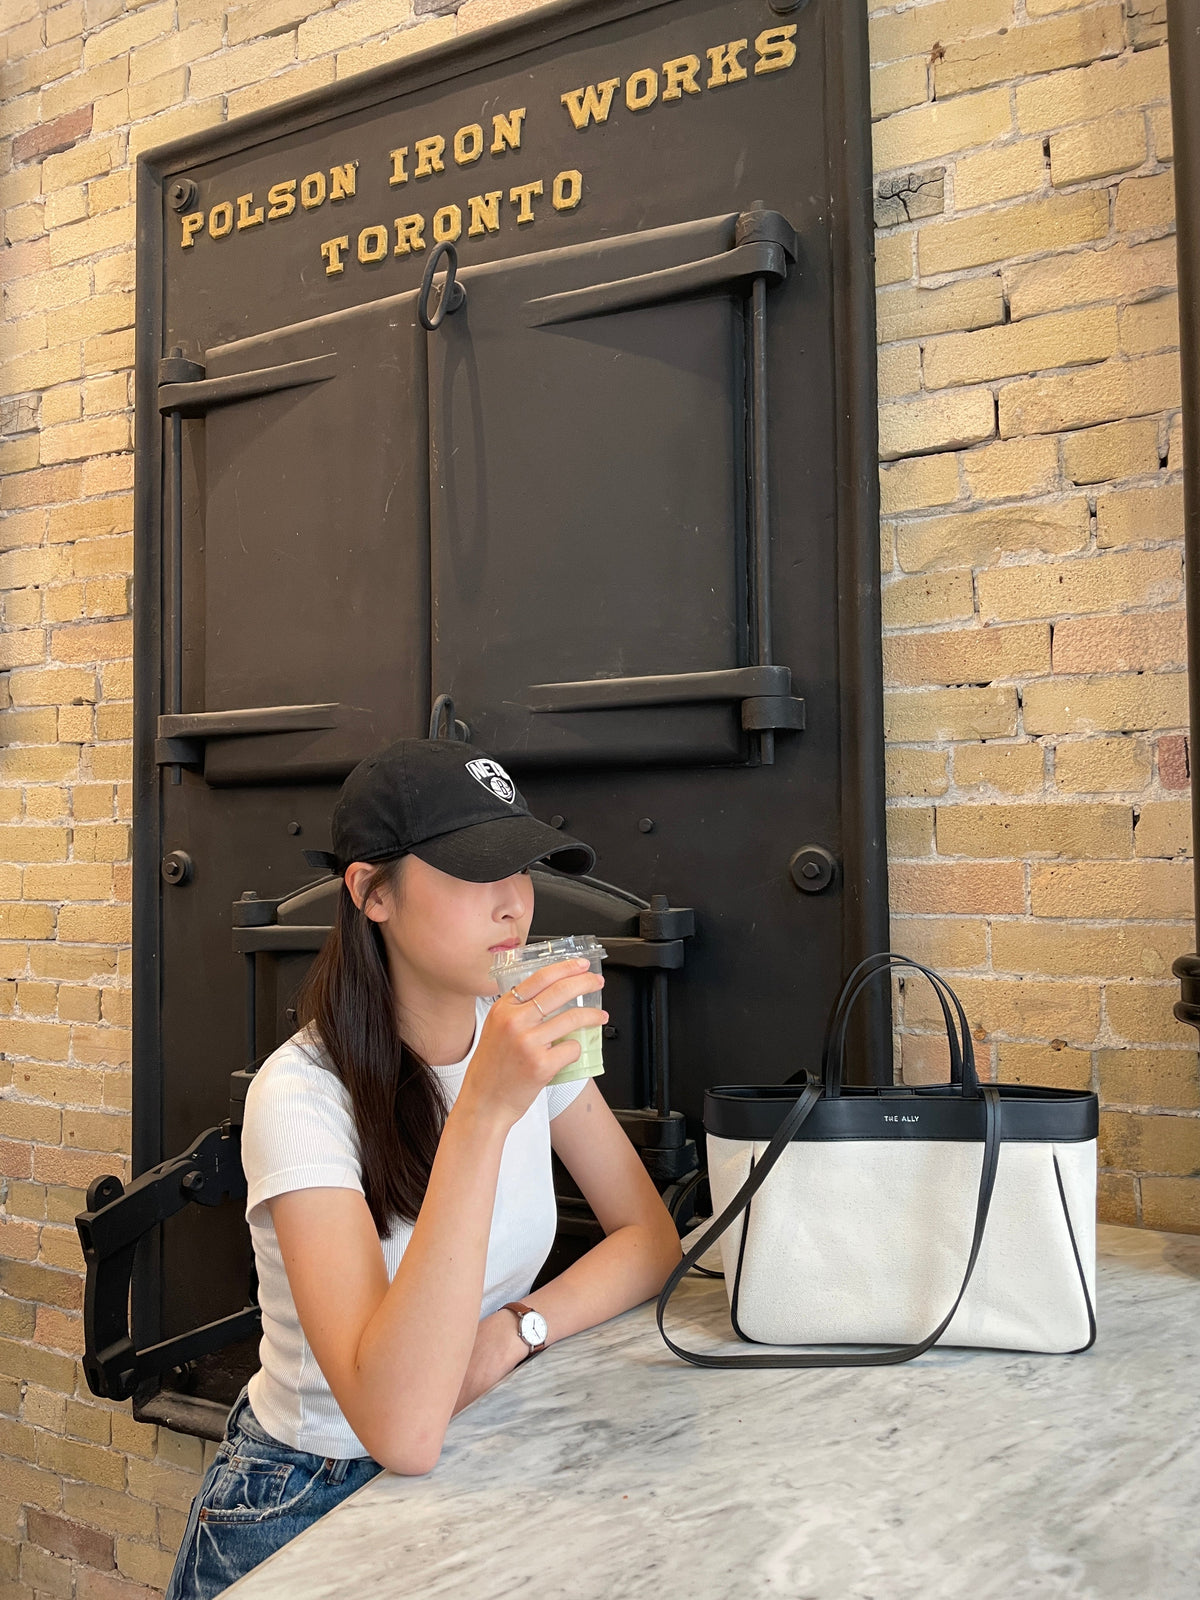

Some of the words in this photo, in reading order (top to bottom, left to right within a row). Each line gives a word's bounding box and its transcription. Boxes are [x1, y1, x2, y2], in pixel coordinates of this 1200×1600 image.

[180, 161, 359, 250] POLSON
[388, 106, 528, 187] IRON
[559, 23, 798, 130] WORKS
[320, 169, 584, 277] TORONTO
[901, 1115, 920, 1123] ALLY
